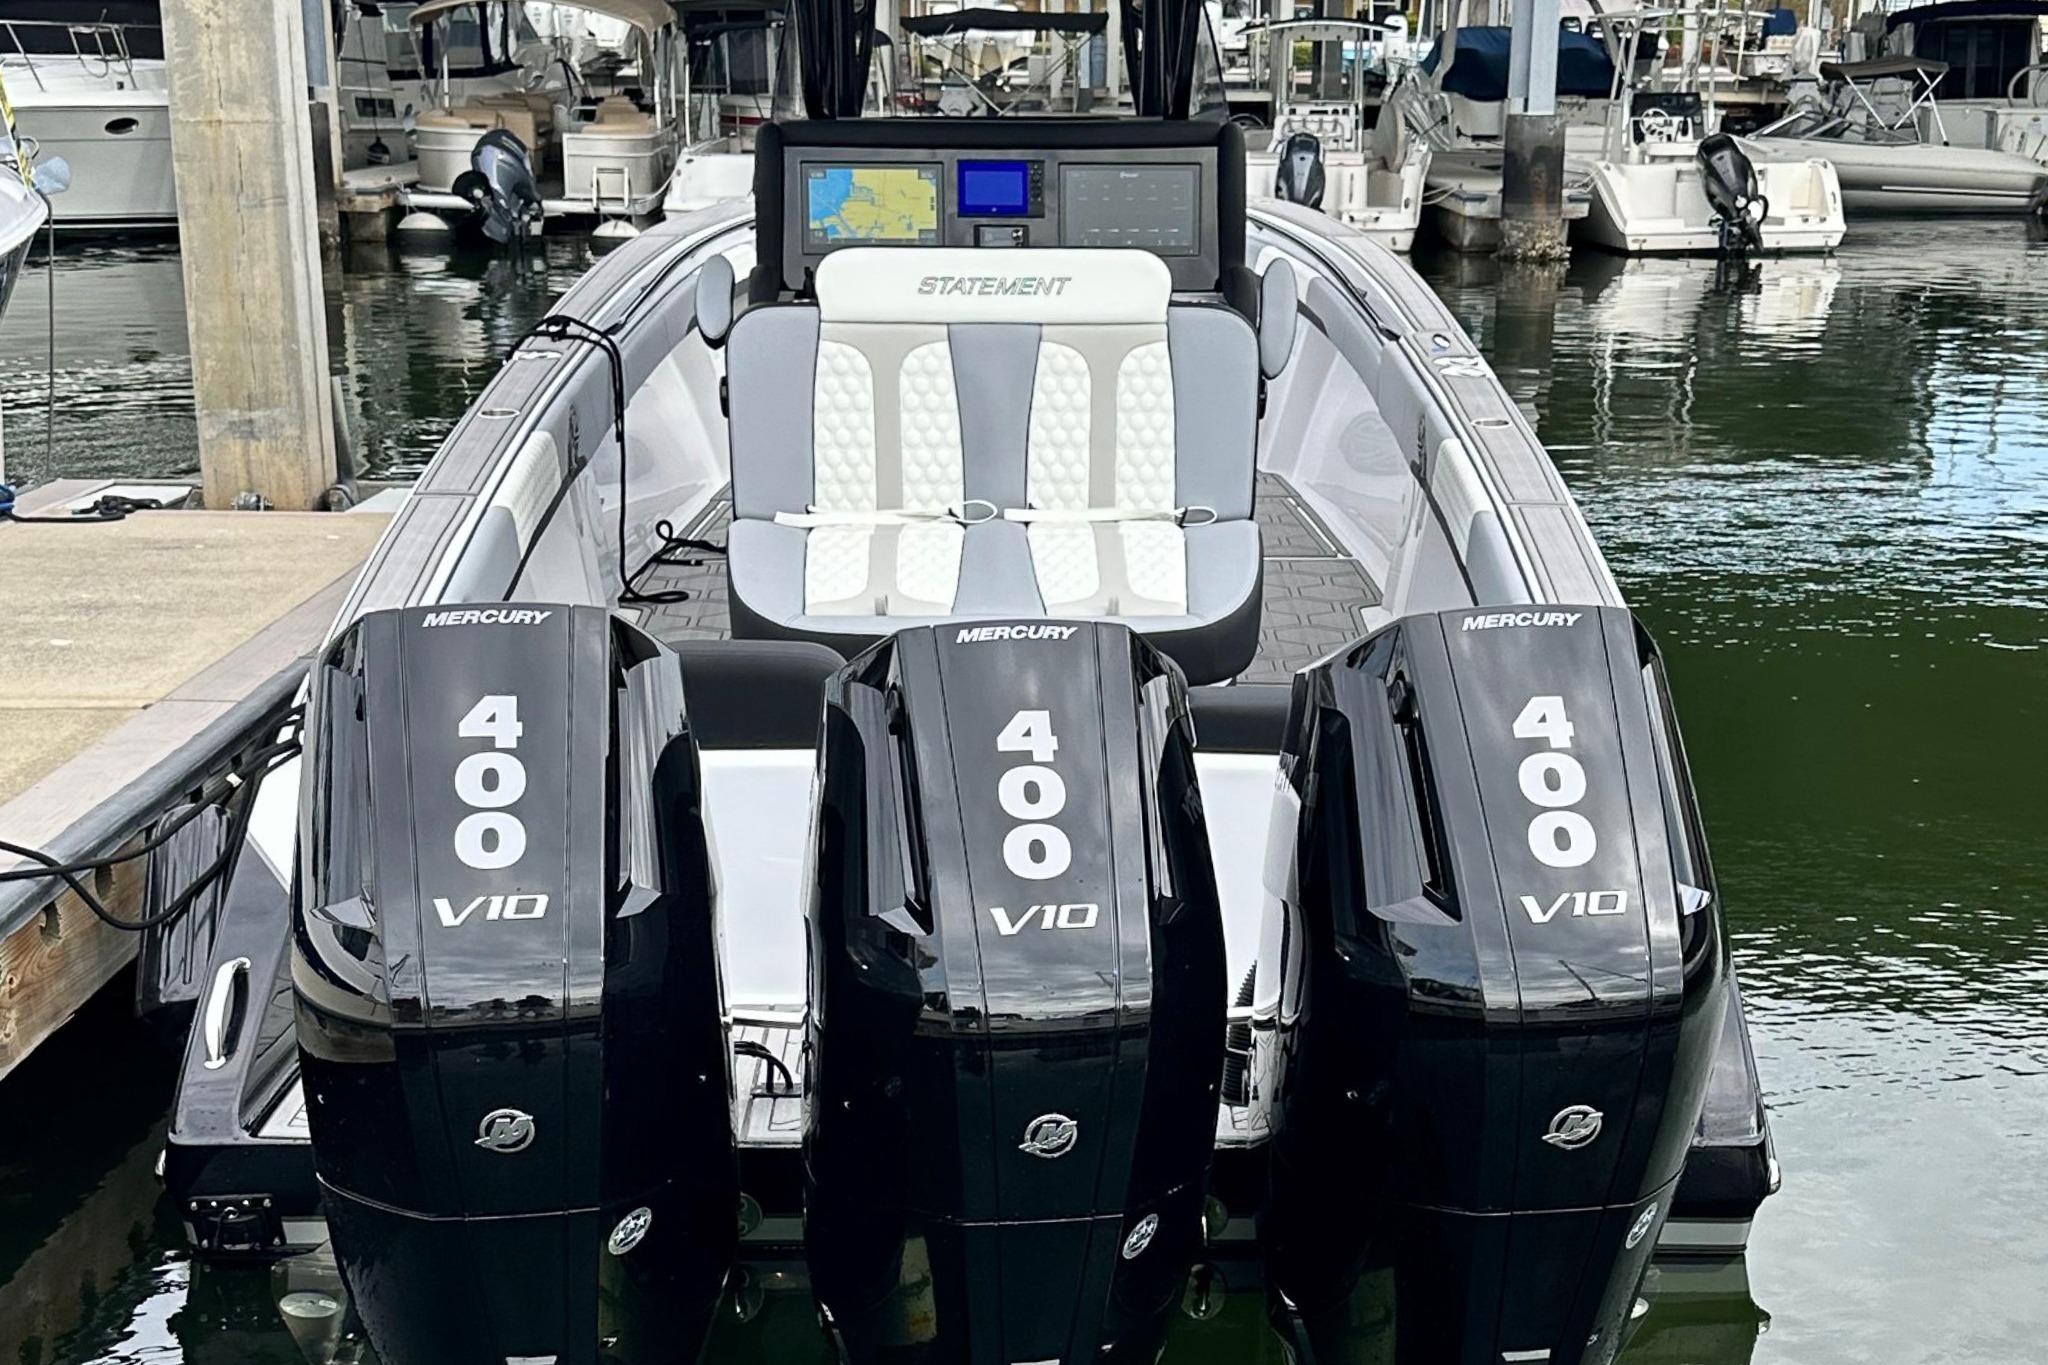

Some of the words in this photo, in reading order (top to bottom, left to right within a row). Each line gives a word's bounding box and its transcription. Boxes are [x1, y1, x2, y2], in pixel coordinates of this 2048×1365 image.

[917, 276, 1072, 296] STATEMENT
[423, 610, 552, 627] MERCURY
[957, 625, 1077, 643] MERCURY
[1462, 612, 1581, 631] MERCURY
[454, 695, 527, 870] 400
[996, 710, 1072, 880] 400
[1512, 695, 1597, 868] 400
[432, 893, 549, 927] V10
[989, 903, 1099, 936] V10
[1519, 889, 1629, 924] V10
